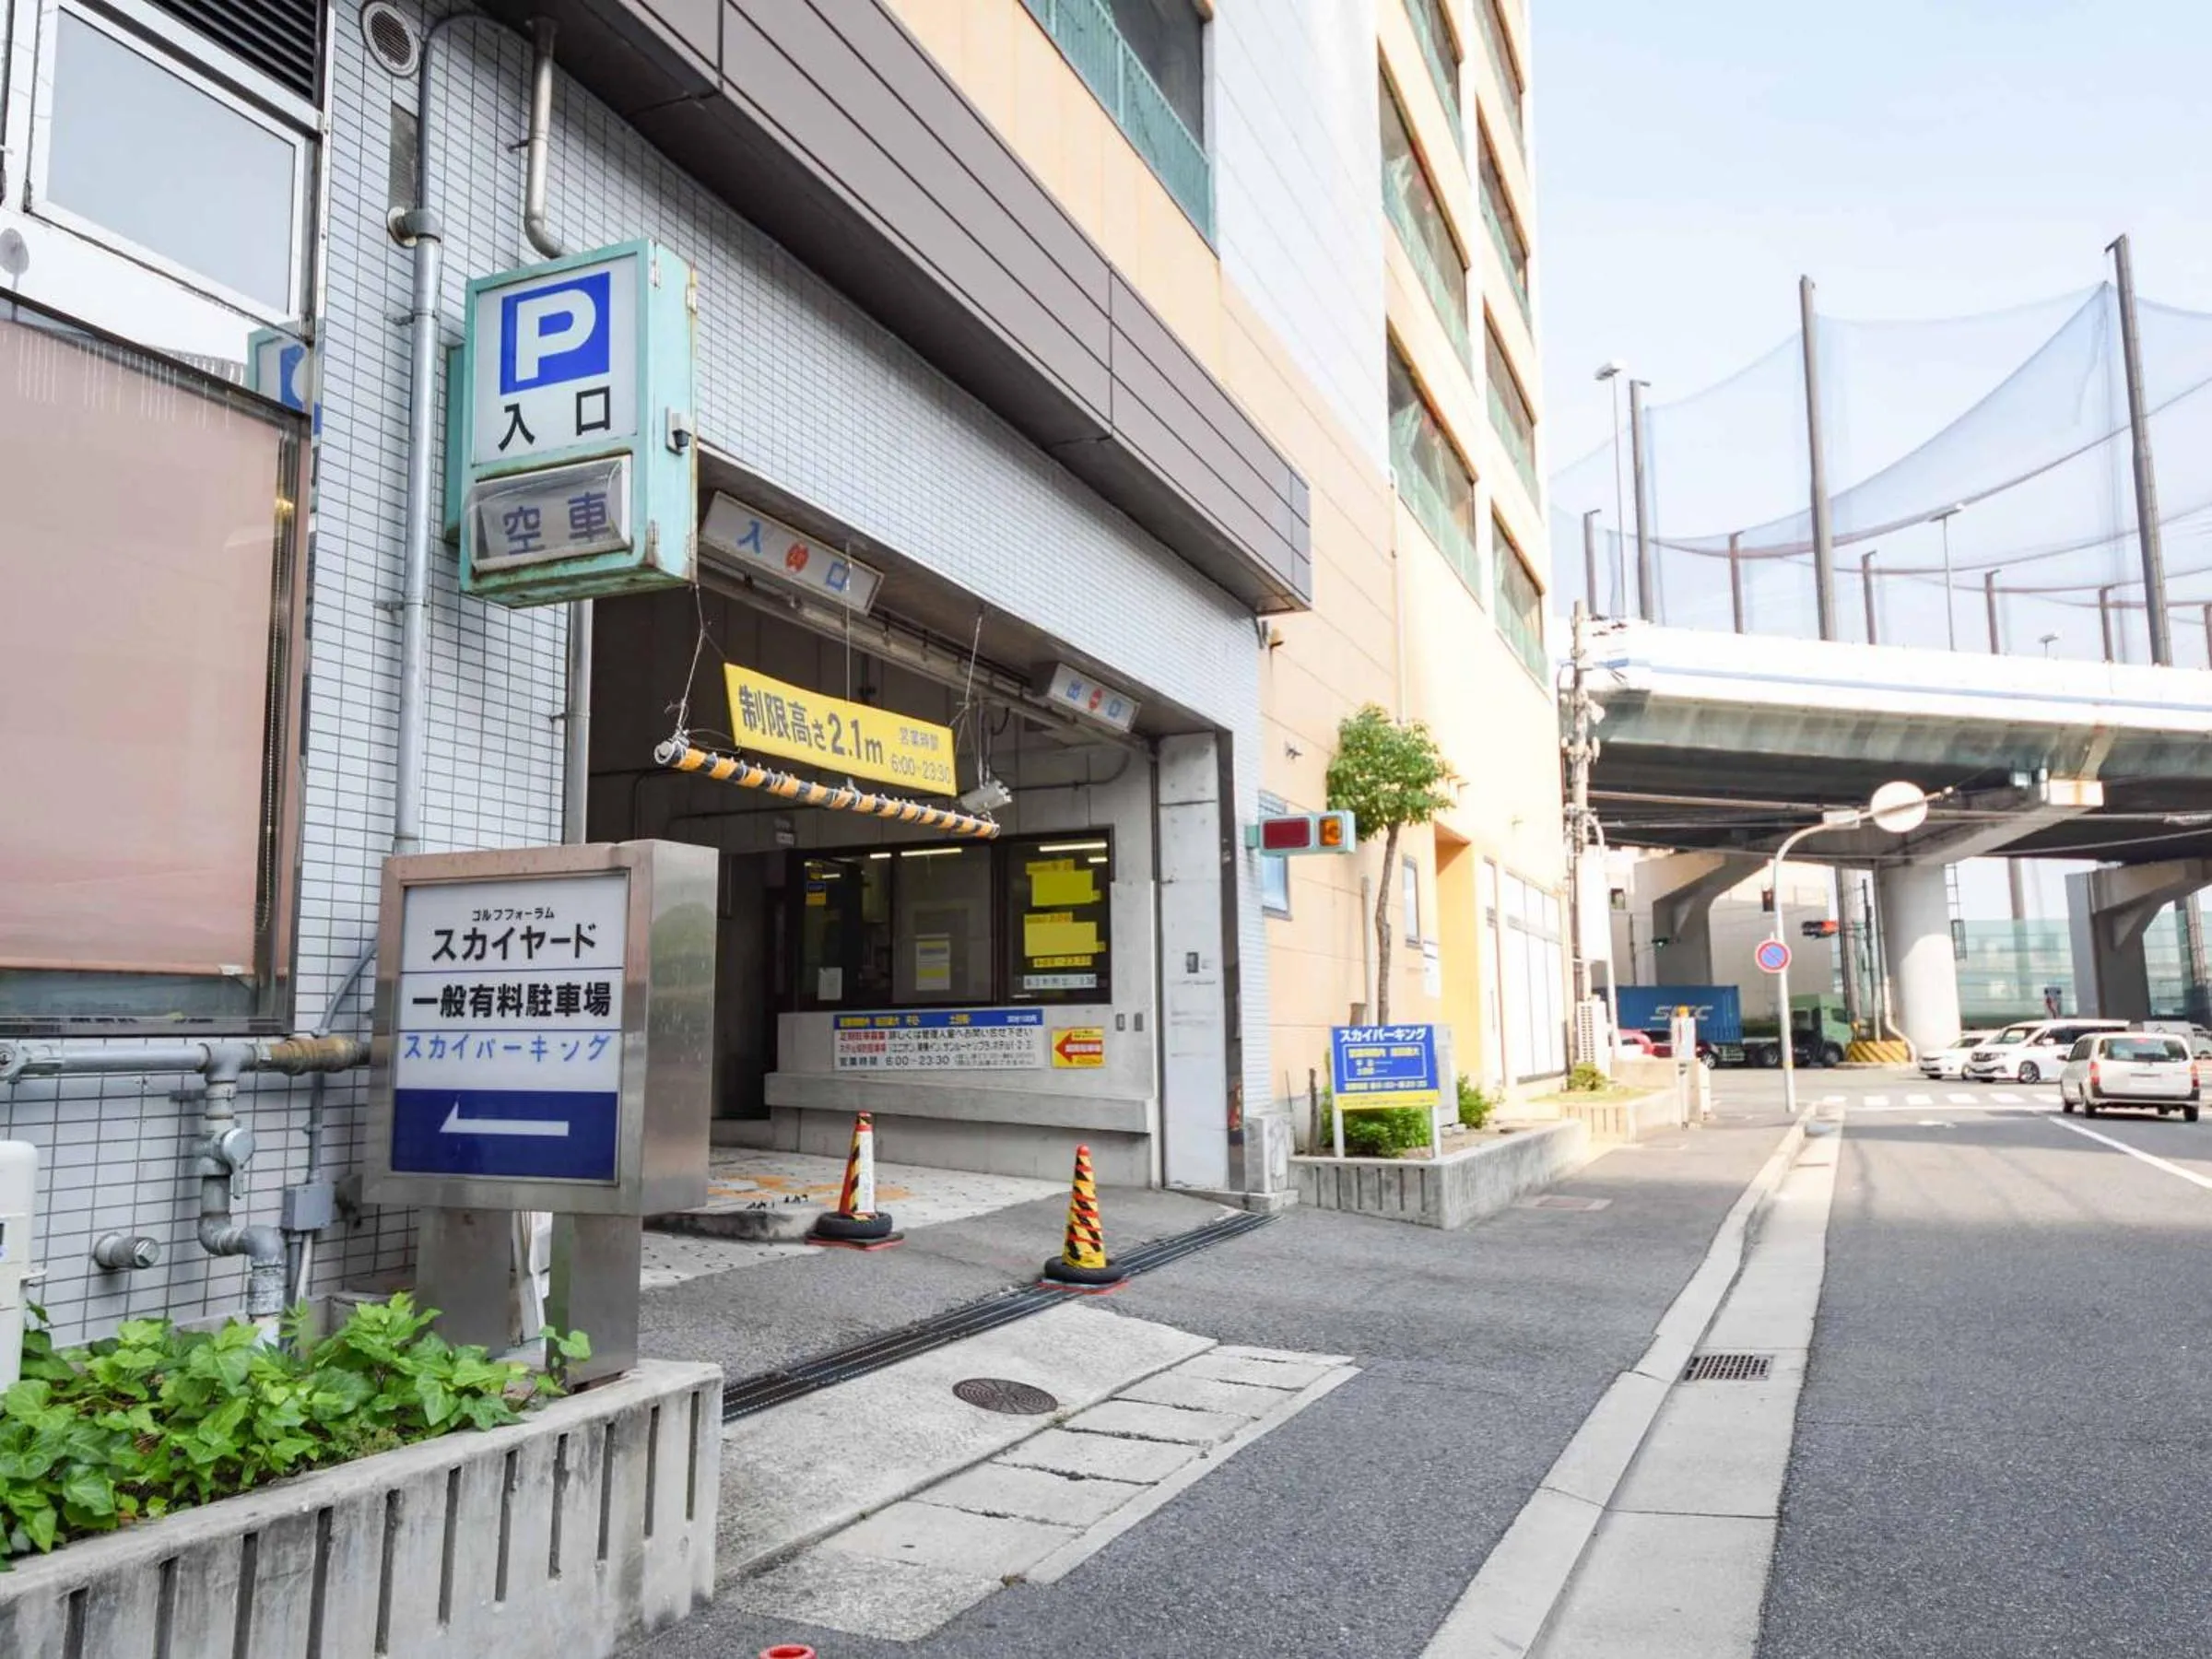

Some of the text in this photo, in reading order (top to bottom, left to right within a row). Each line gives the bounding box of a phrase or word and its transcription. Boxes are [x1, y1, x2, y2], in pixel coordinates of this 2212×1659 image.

[514, 288, 597, 383] P
[498, 385, 612, 453] 入口
[502, 491, 611, 556] 空車
[471, 907, 555, 923] ゴルフフォーラム
[431, 923, 597, 962] スカイヤード
[412, 982, 612, 1018] 一般有料駐車場
[404, 1033, 612, 1063] スカイパーキング
